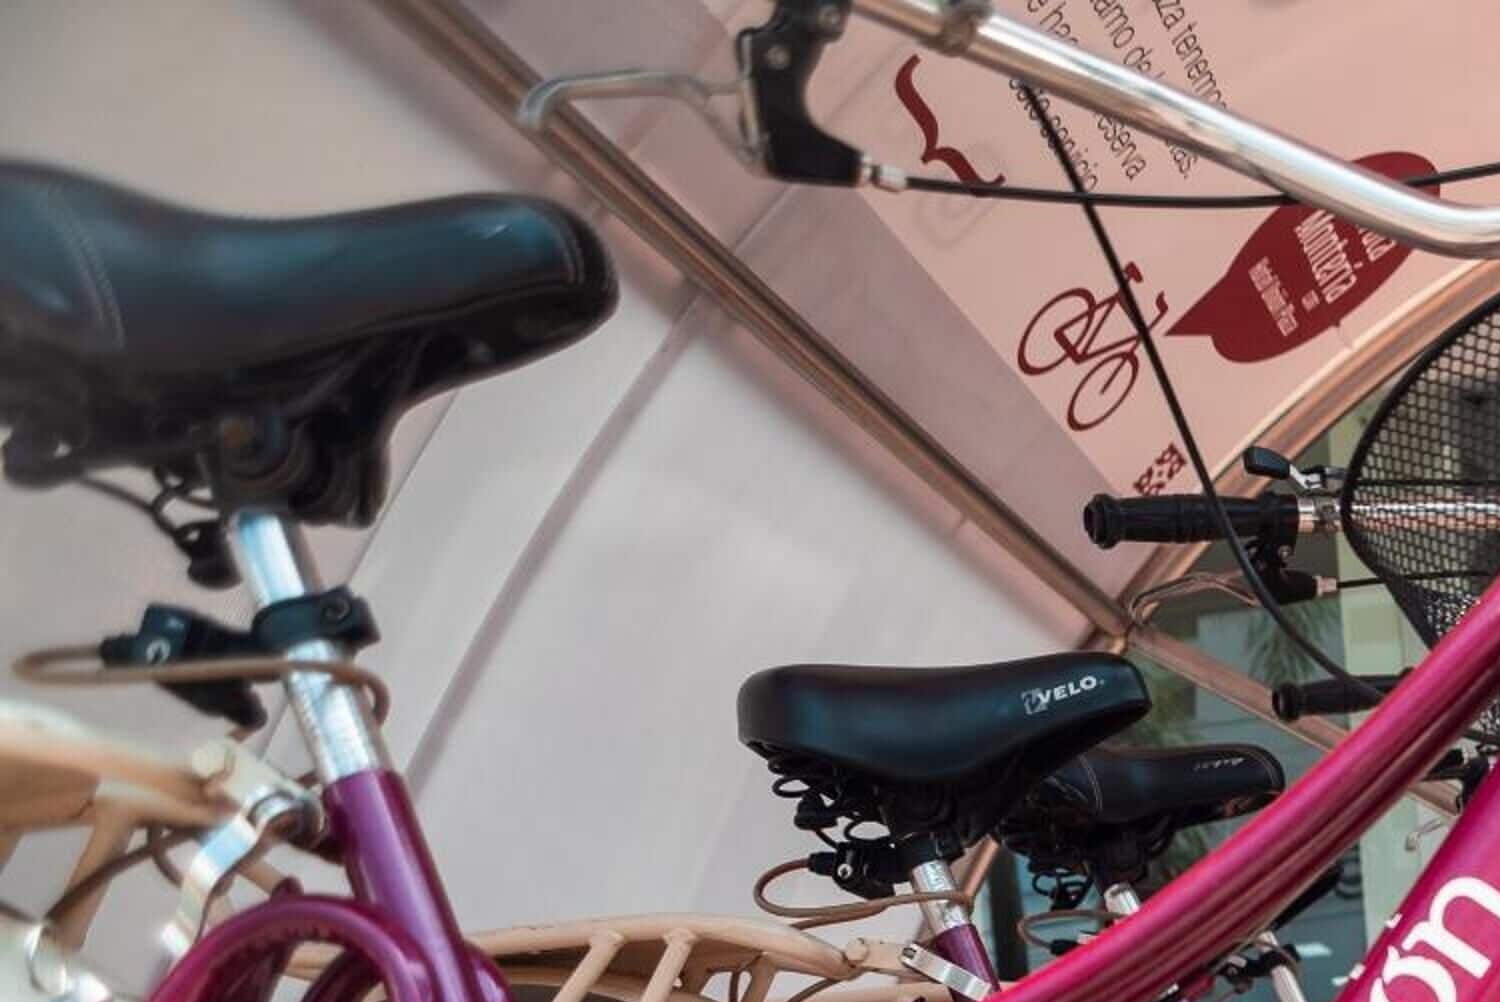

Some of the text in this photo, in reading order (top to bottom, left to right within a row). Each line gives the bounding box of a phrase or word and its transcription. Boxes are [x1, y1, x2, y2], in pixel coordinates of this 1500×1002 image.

[1088, 0, 1136, 49] amo
[1096, 112, 1147, 181] eserva
[1036, 675, 1099, 705] VELO
